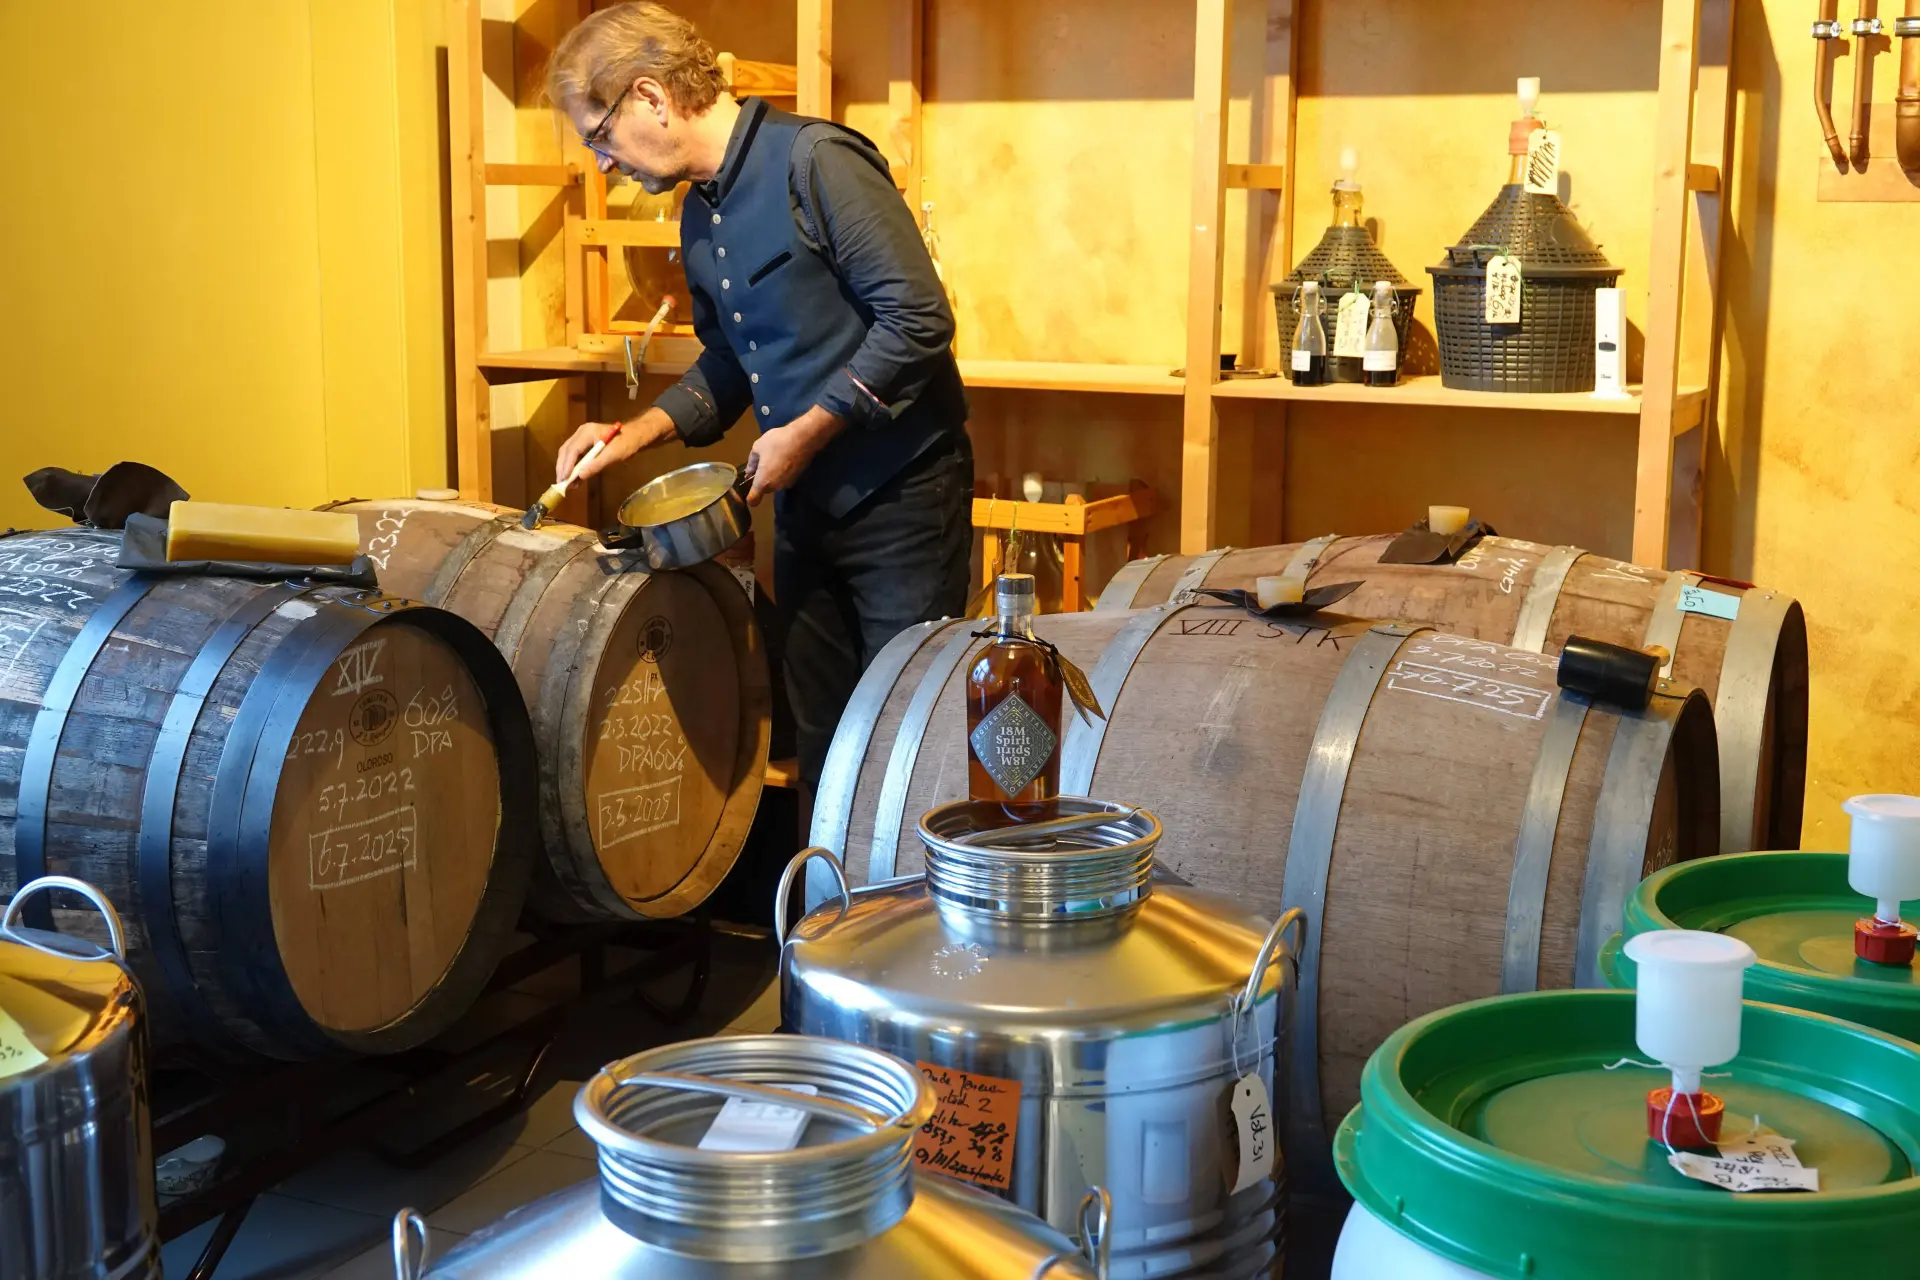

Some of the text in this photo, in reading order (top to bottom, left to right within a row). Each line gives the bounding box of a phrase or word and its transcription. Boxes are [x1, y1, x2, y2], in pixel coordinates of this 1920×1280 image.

[1168, 619, 1250, 636] VIII
[331, 637, 387, 695] XIV
[404, 684, 459, 728] 60%
[600, 713, 672, 741] 2.3.2022
[1000, 726, 1026, 736] 18M
[410, 730, 453, 758] DPA
[996, 735, 1031, 747] Spirit
[996, 745, 1031, 757] Spirit
[356, 752, 394, 773] OLOROSO
[319, 826, 414, 880] 6.7.2025
